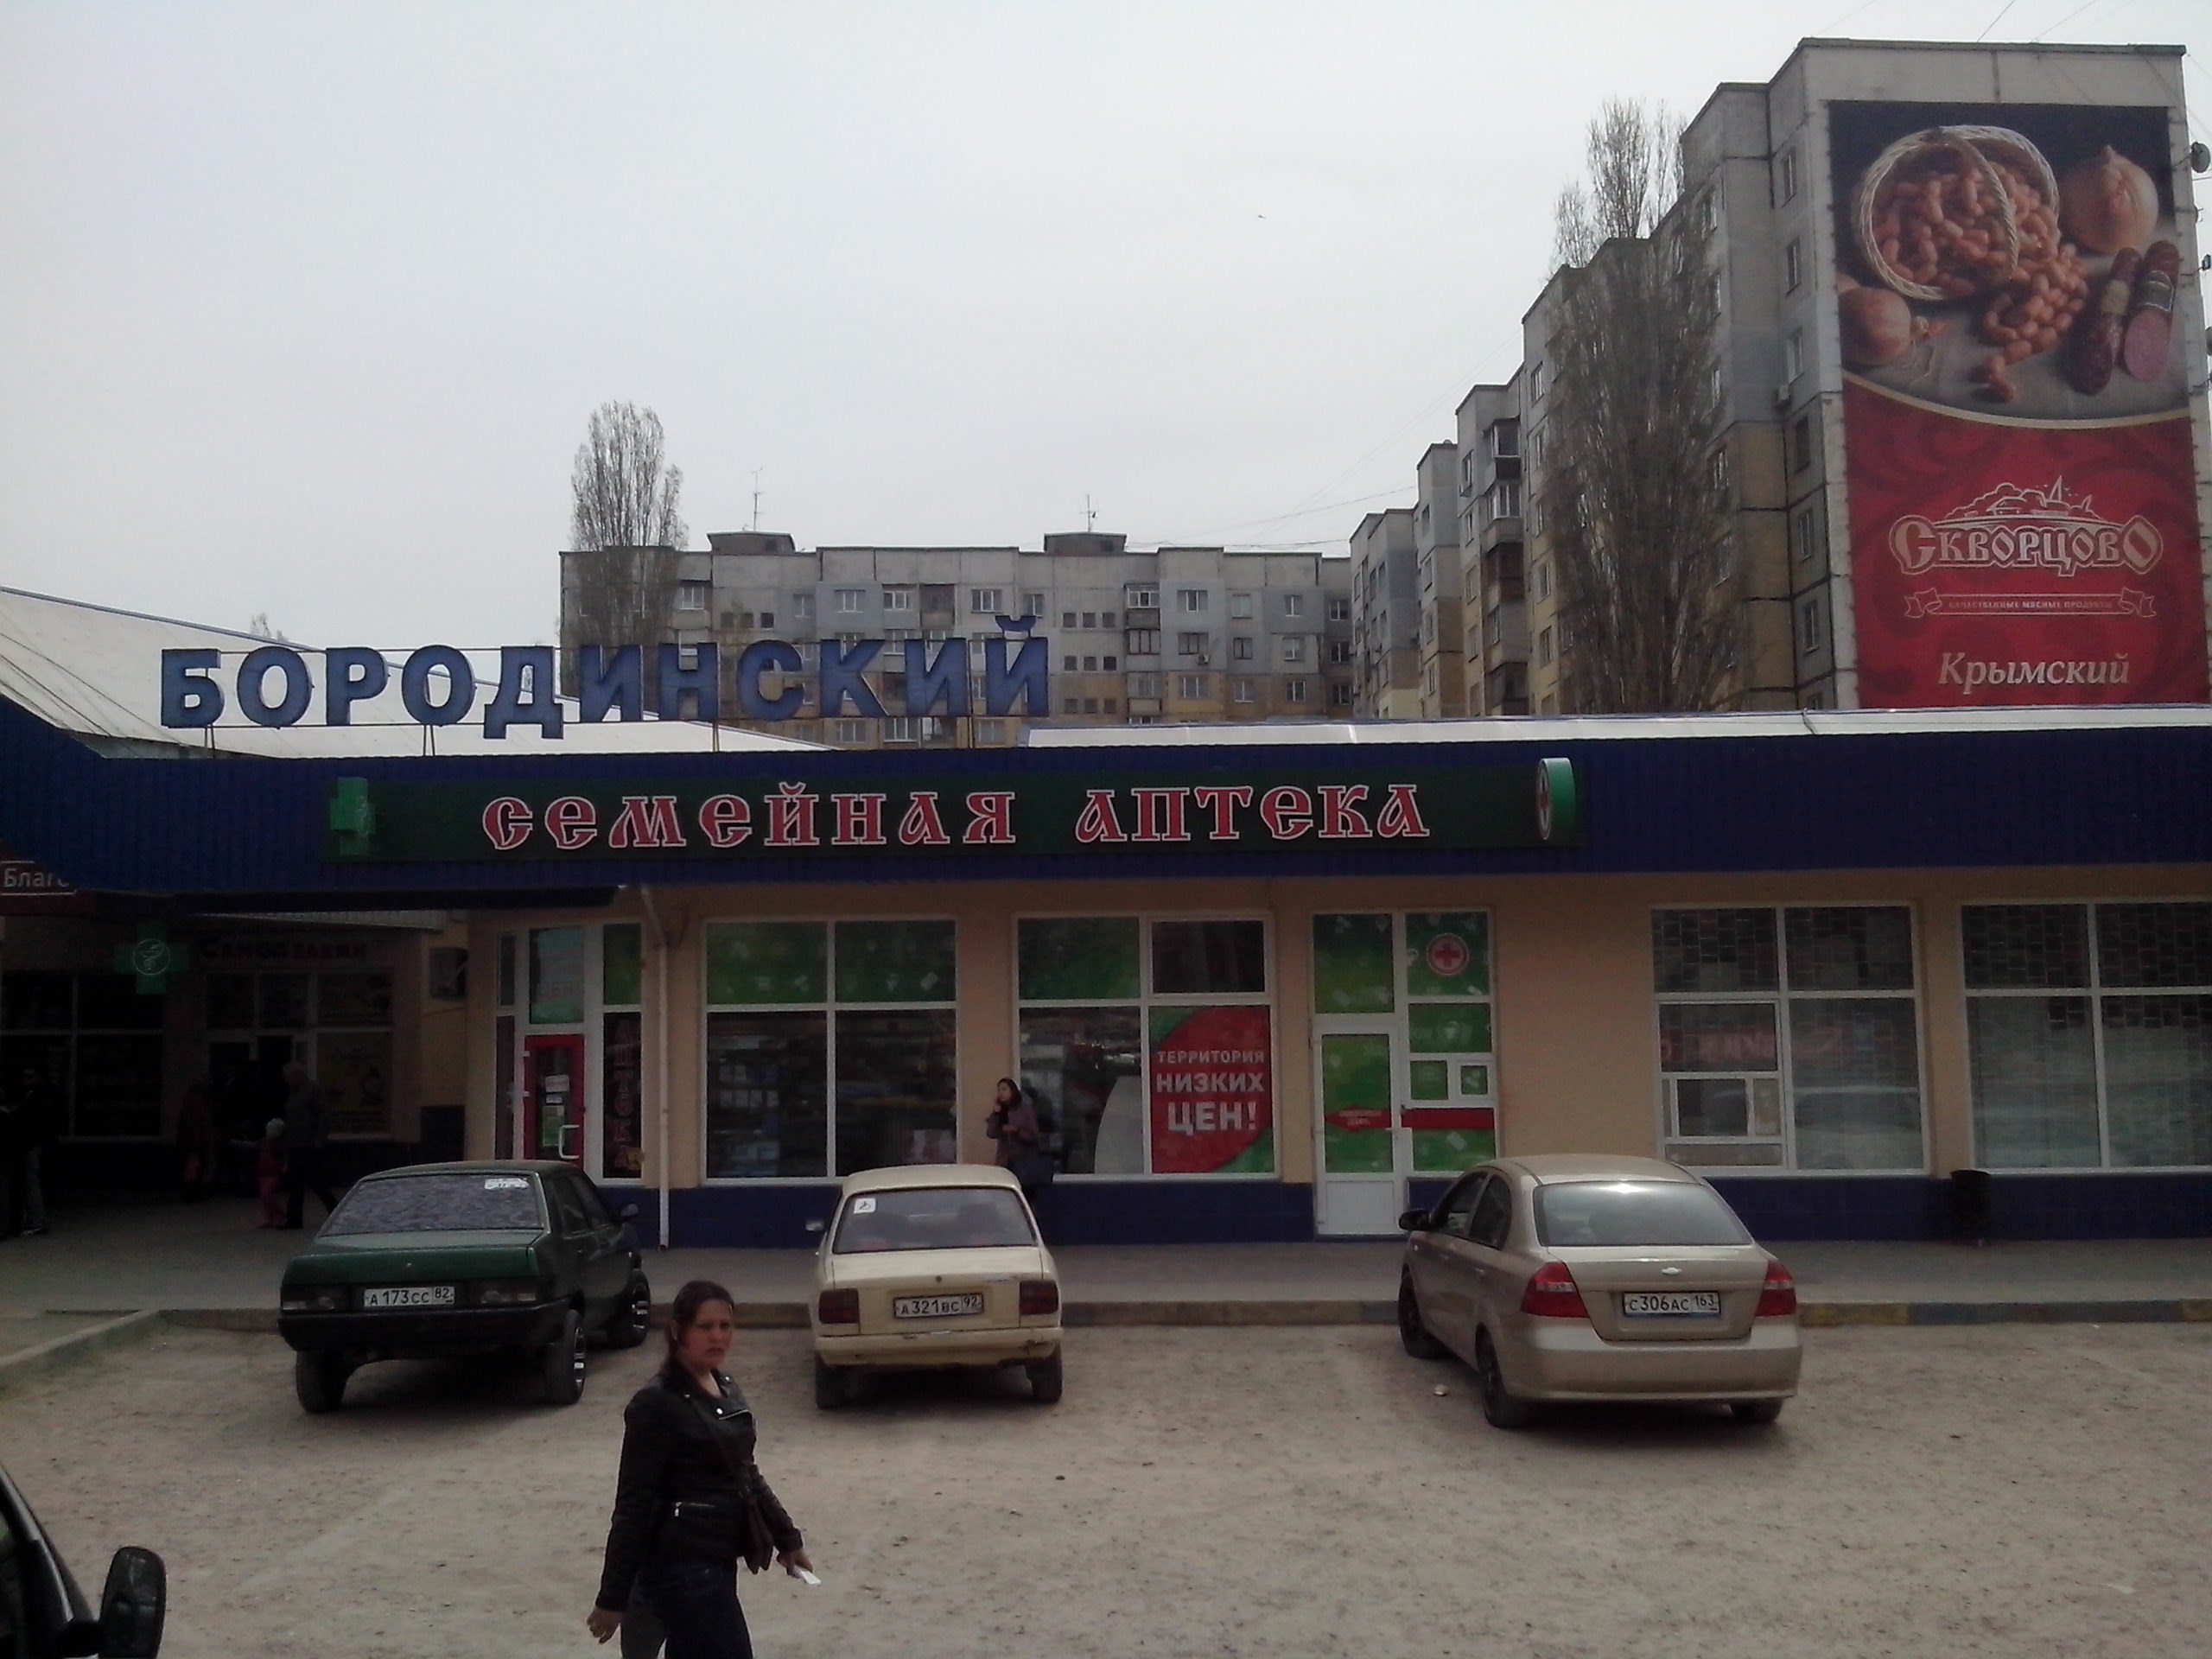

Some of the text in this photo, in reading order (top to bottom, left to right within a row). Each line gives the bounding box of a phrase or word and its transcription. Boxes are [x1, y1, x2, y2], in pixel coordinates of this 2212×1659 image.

[161, 615, 1051, 740] БОРОДИНСКИЙ
[1938, 651, 2131, 696] Крымский
[1157, 1048, 1265, 1064] ТЕРРИТОРИЯ
[1156, 1072, 1265, 1094] НИЗКИХ
[1166, 1101, 1258, 1136] ЦЕН!
